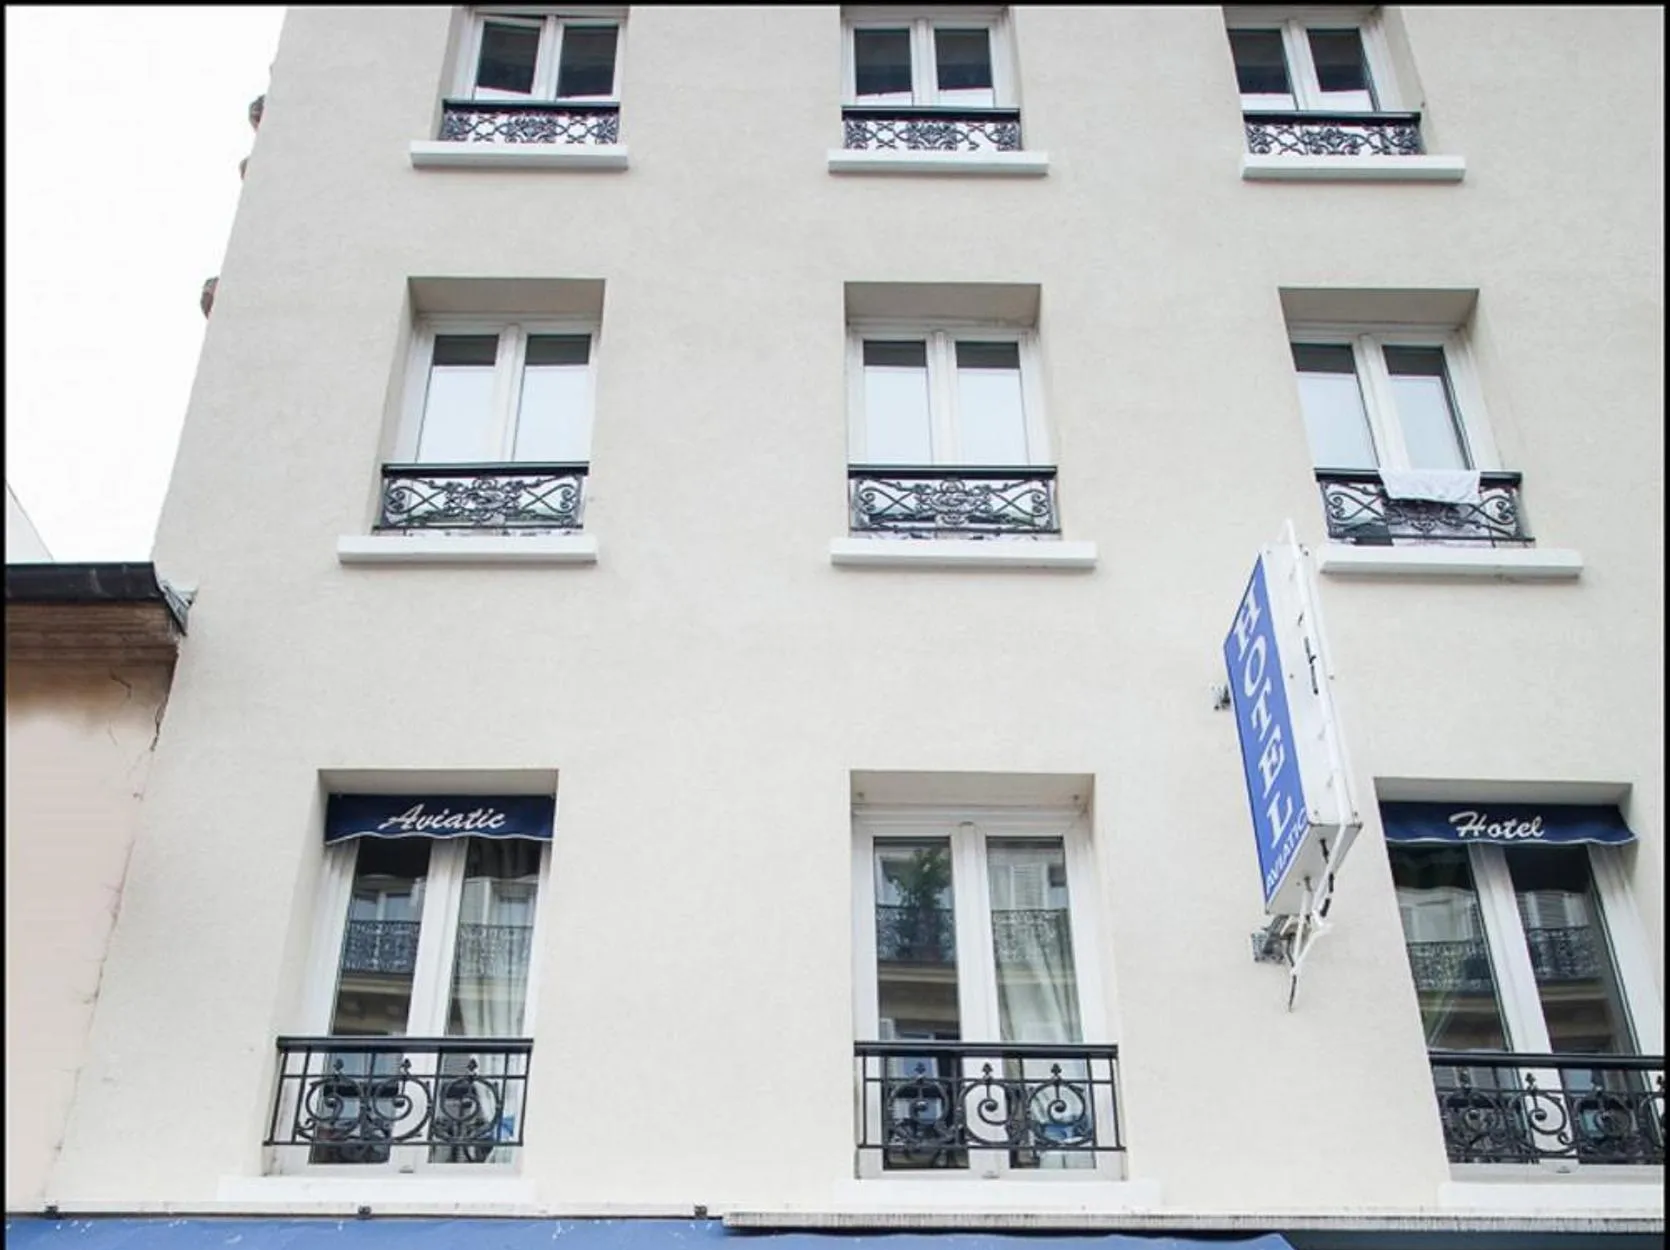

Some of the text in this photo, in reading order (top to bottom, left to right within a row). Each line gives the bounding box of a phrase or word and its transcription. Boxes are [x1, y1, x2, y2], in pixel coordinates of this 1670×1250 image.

[1233, 583, 1294, 850] HOTEL
[378, 803, 507, 831] Aviatic
[1448, 810, 1546, 839] Hotel
[1265, 806, 1309, 896] AVIATIC
